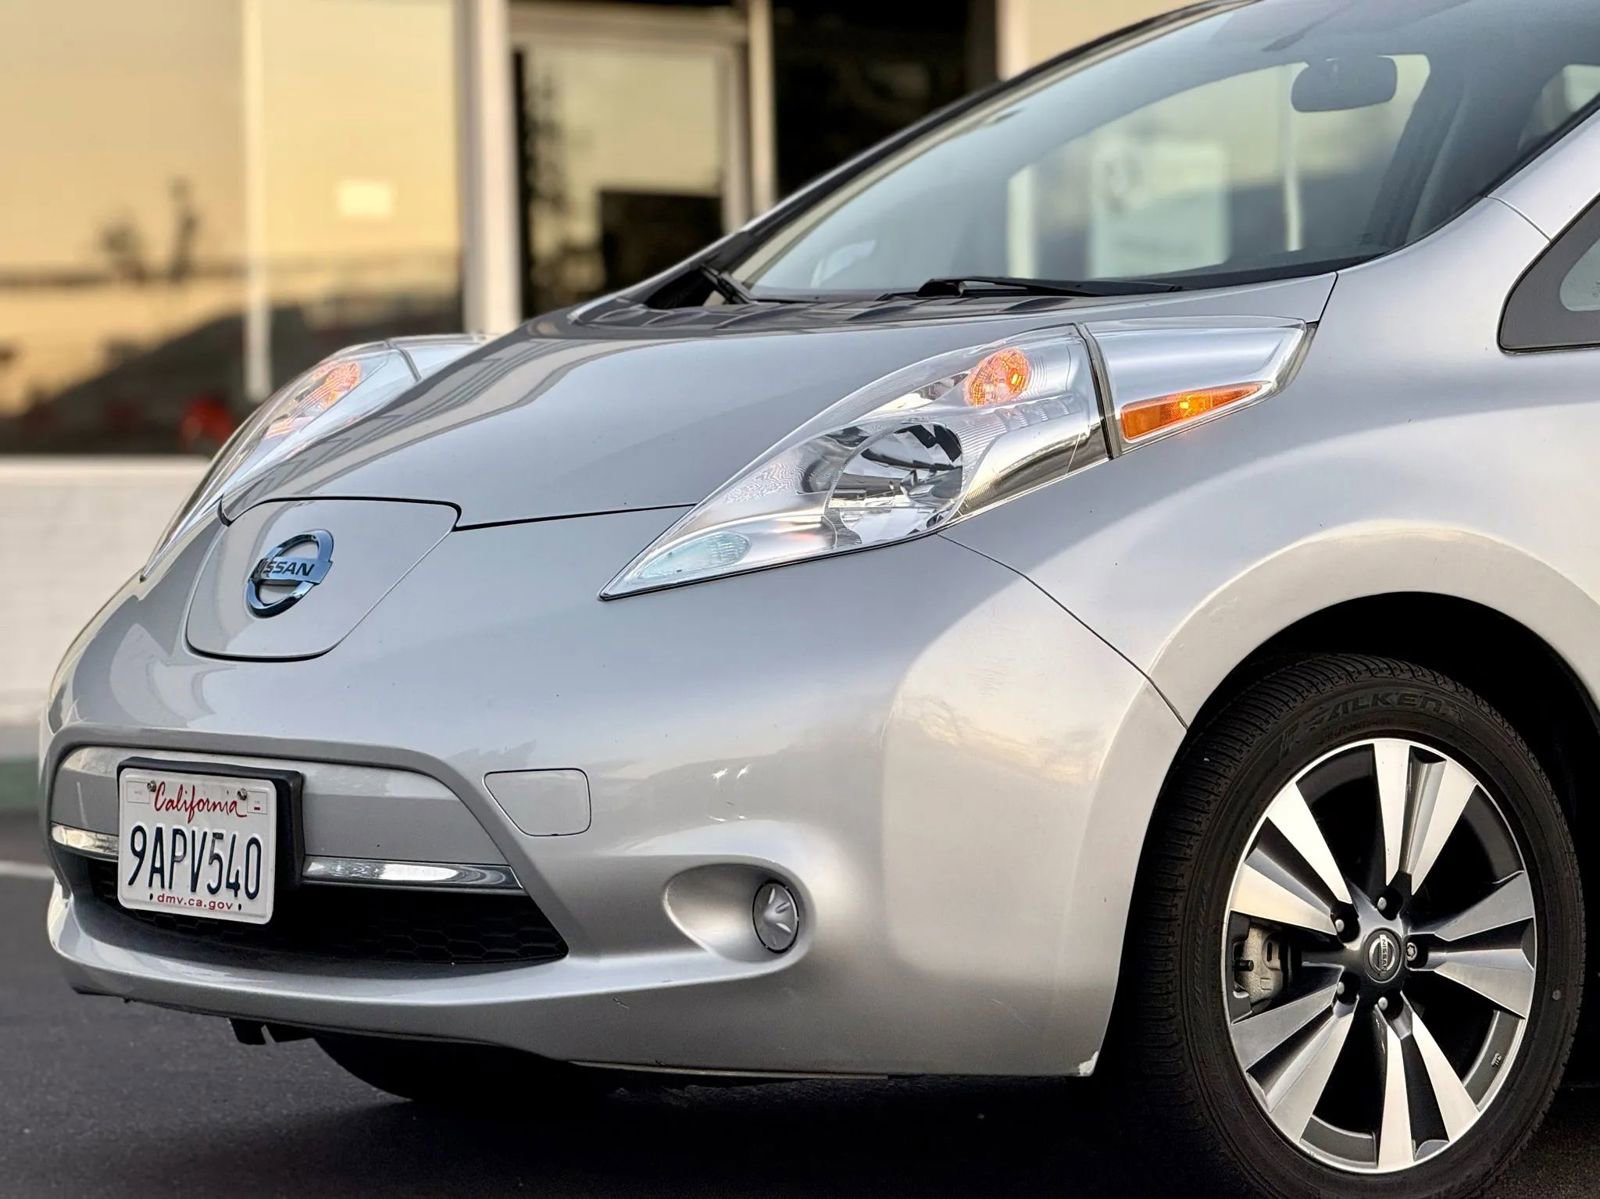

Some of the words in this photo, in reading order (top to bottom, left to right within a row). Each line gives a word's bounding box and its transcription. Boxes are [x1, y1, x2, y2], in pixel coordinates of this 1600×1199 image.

[154, 781, 247, 823] California
[128, 825, 262, 900] 9APV540
[157, 893, 233, 910] dmv.ca.gov
